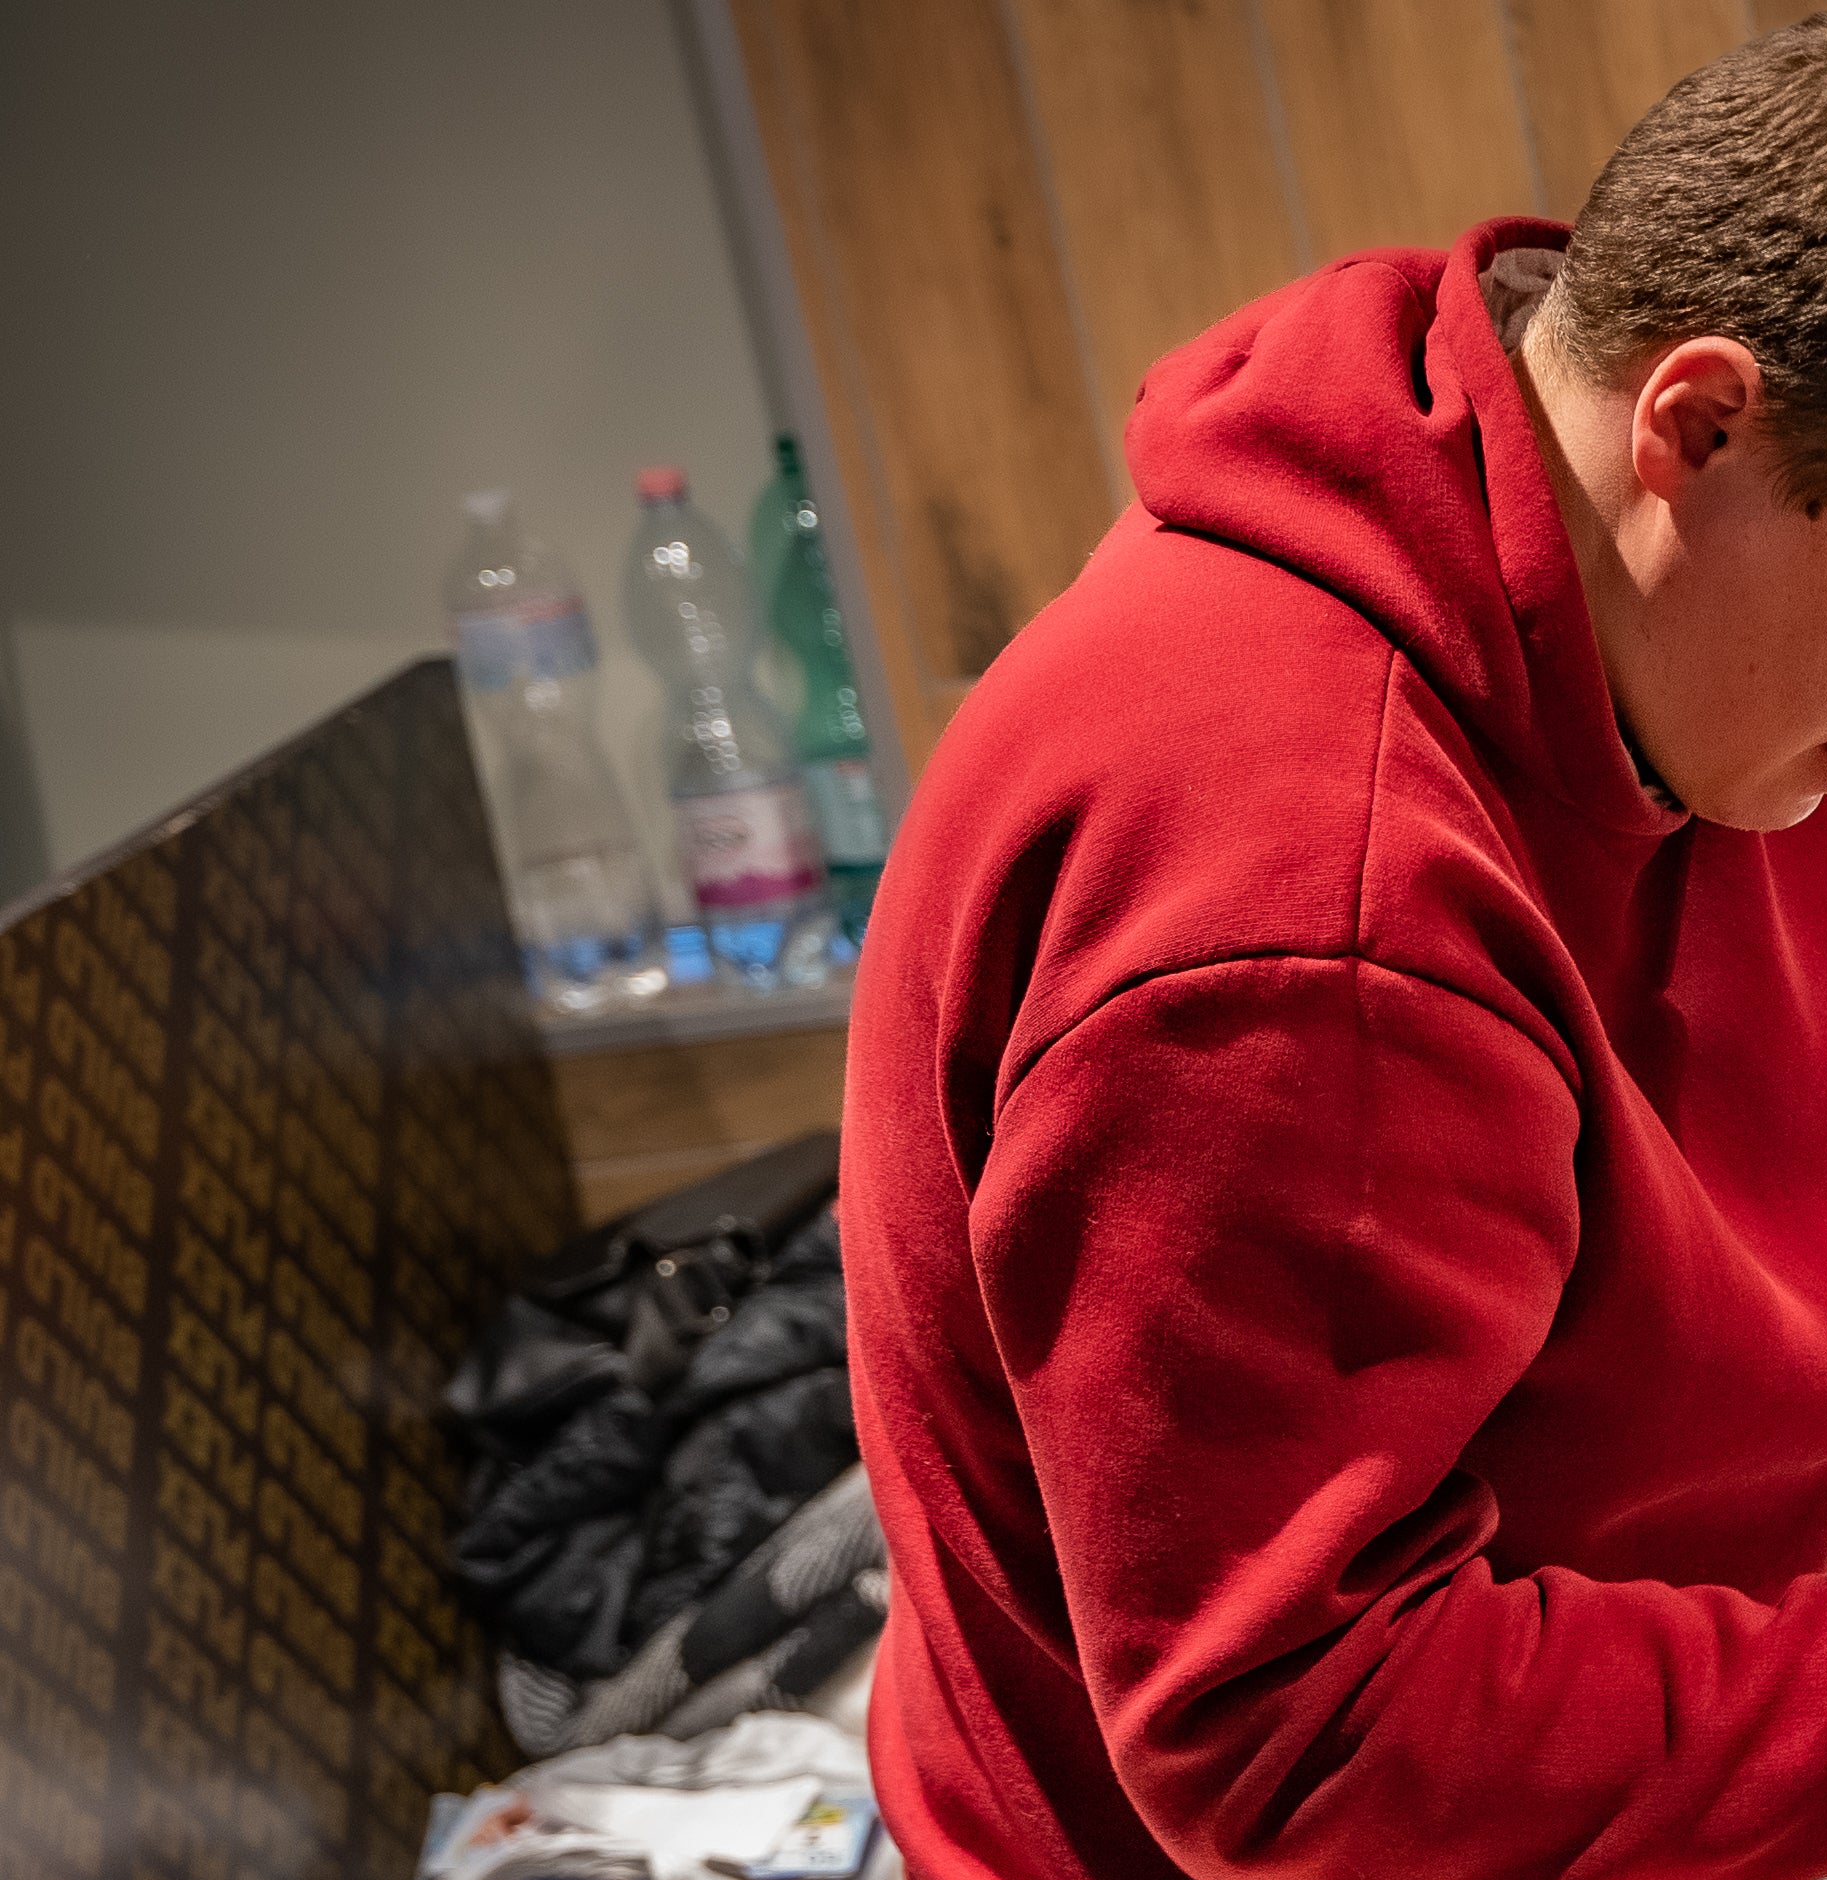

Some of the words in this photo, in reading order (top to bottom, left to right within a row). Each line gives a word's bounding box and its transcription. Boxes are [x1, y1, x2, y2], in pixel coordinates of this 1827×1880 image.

[31, 1155, 148, 1315] BUILD
[23, 1235, 142, 1396] BUILD
[166, 1293, 260, 1436] PLEX
[15, 1316, 136, 1472] BUILD
[160, 1371, 254, 1511] PLEX
[8, 1396, 129, 1552] BUILD
